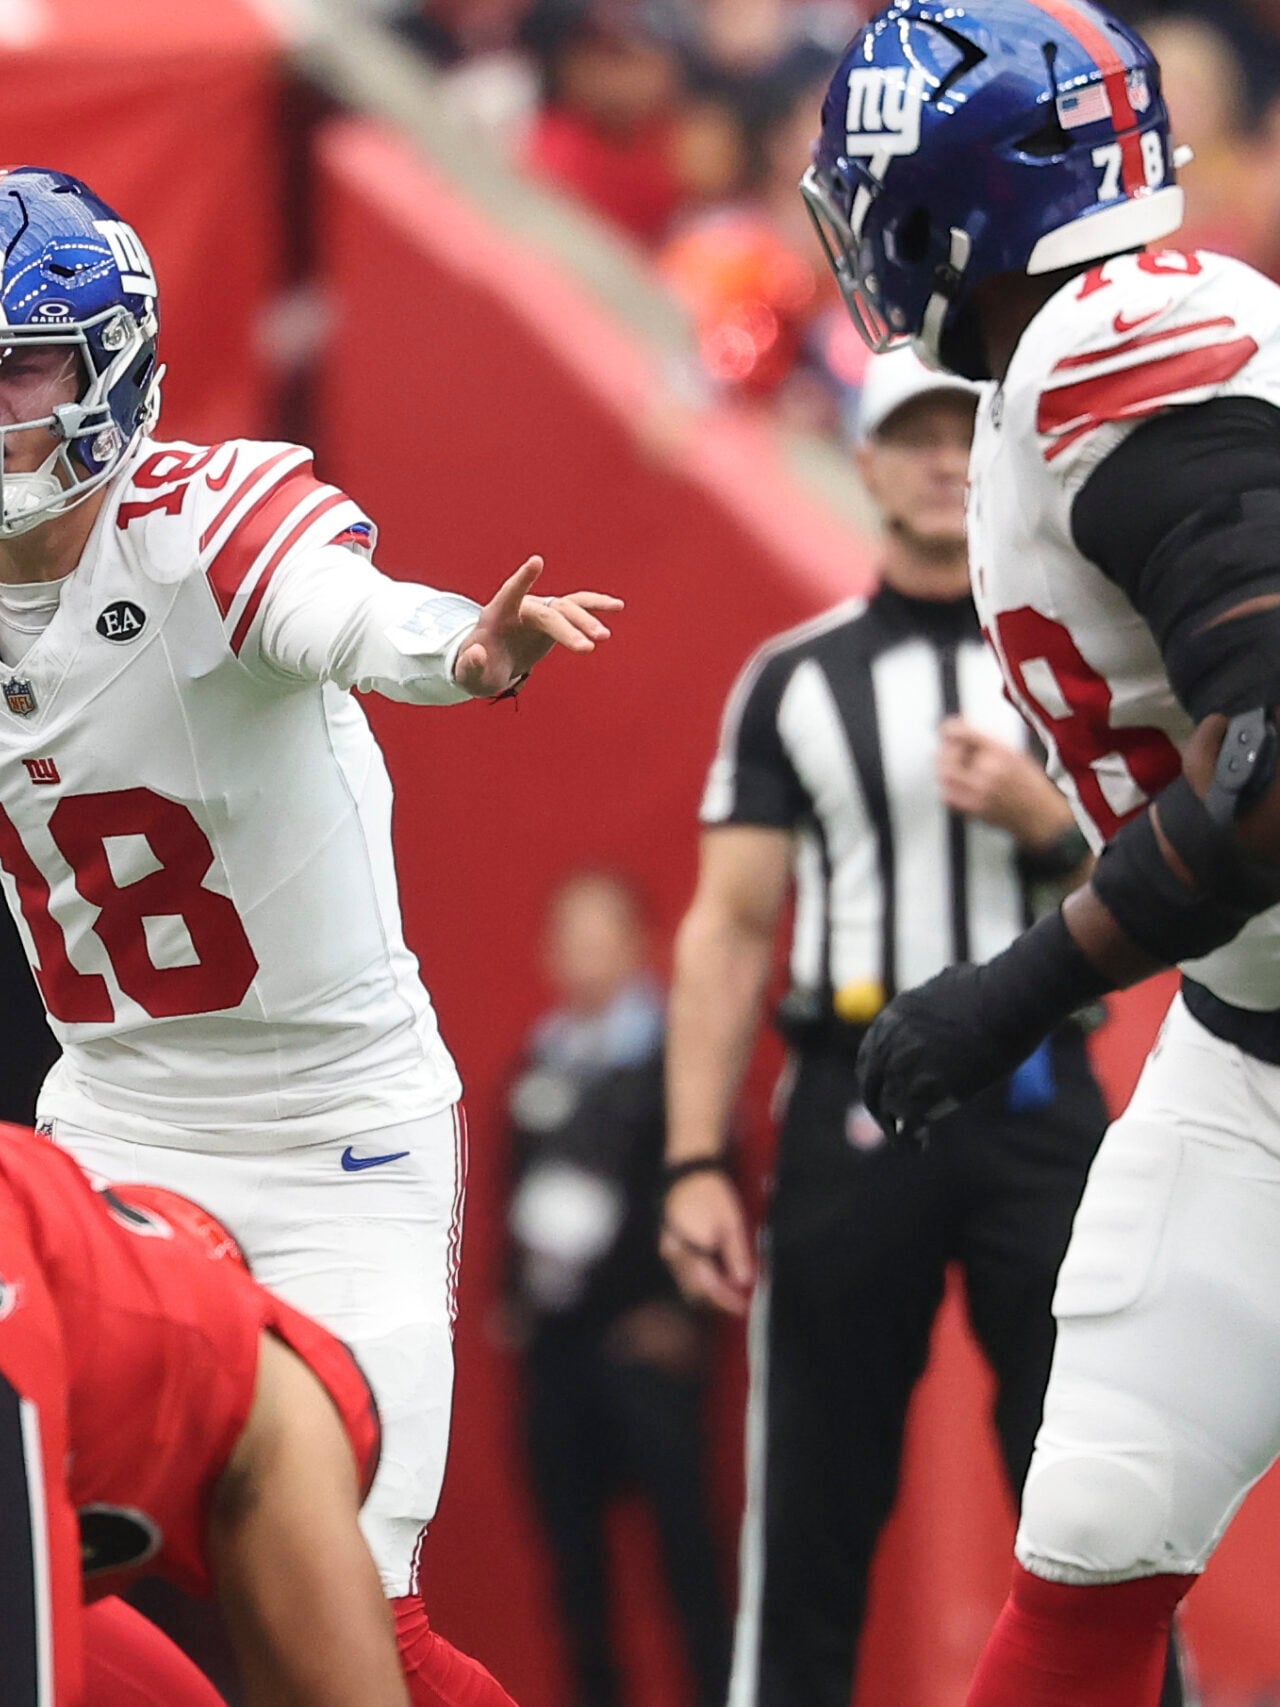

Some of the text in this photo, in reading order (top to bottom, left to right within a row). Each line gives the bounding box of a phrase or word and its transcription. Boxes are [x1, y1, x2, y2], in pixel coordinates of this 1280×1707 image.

[1092, 130, 1164, 201] 78
[31, 315, 76, 324] OAKLEY
[102, 606, 141, 636] EA
[8, 695, 37, 713] NFL
